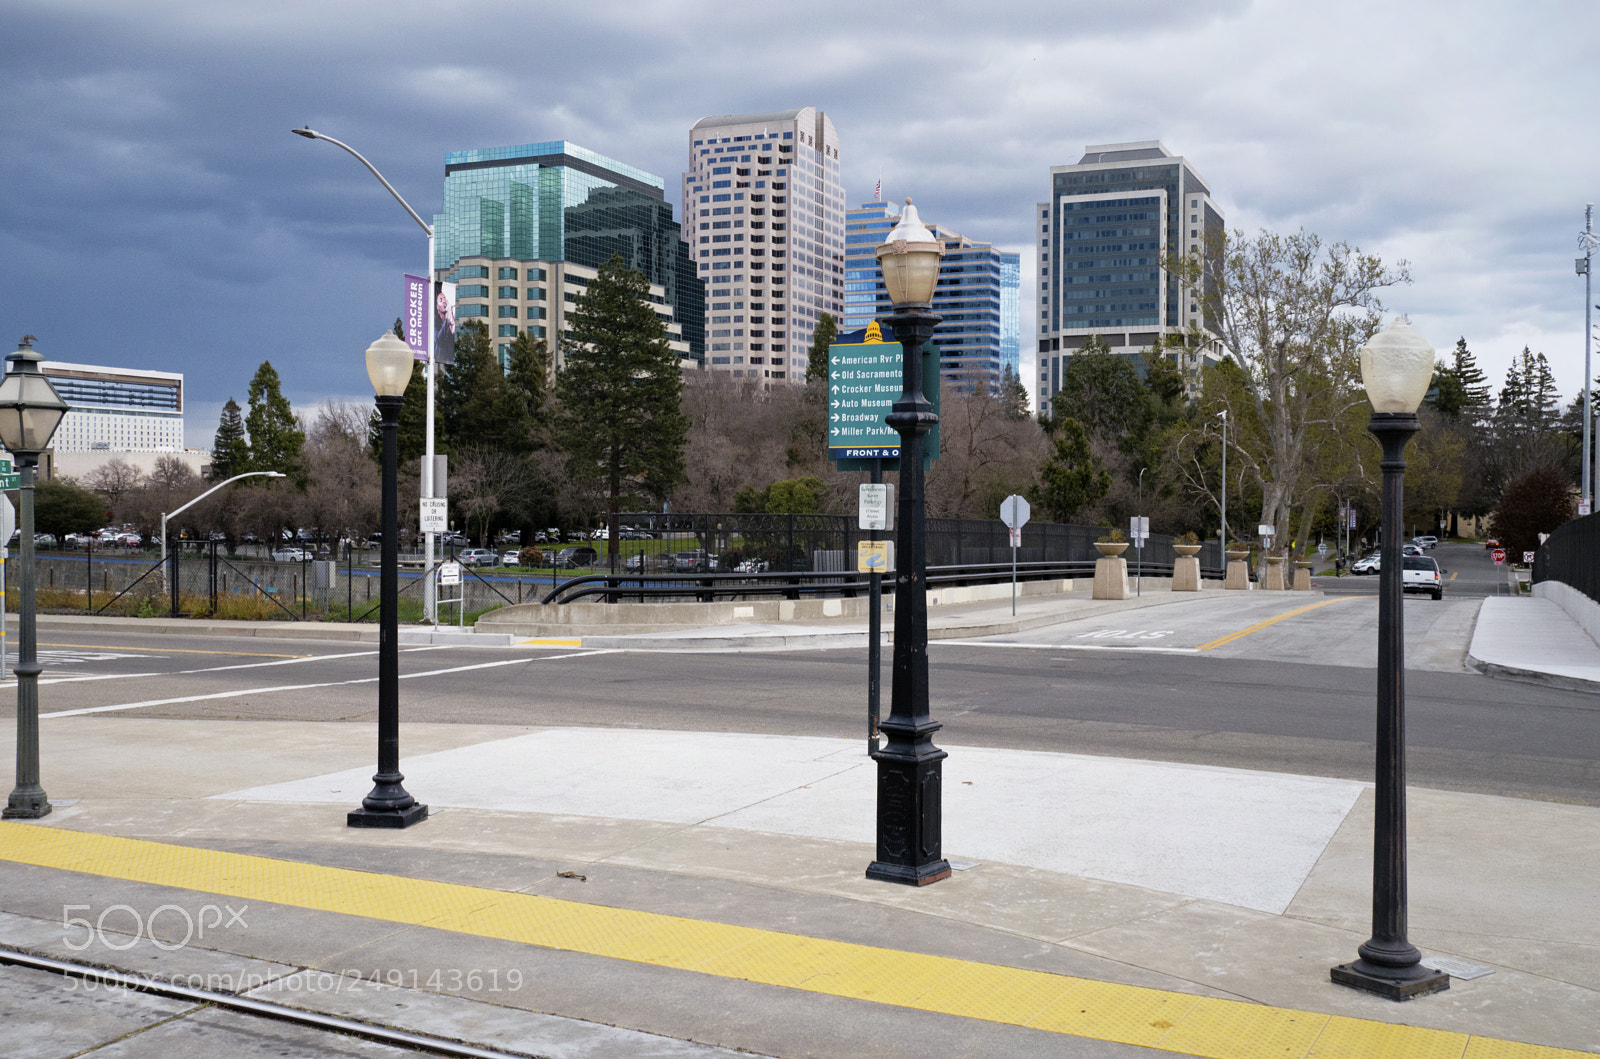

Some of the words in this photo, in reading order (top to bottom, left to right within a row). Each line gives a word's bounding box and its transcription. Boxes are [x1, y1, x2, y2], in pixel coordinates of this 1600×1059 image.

[842, 356, 878, 364] American
[880, 354, 893, 363] Rvr
[842, 370, 854, 379] Old
[856, 370, 903, 379] Sacramento
[842, 384, 872, 393] Crocker
[842, 399, 858, 407] Auto
[861, 399, 892, 407] Museum
[842, 413, 878, 423] Broadway
[842, 427, 864, 436] Miller
